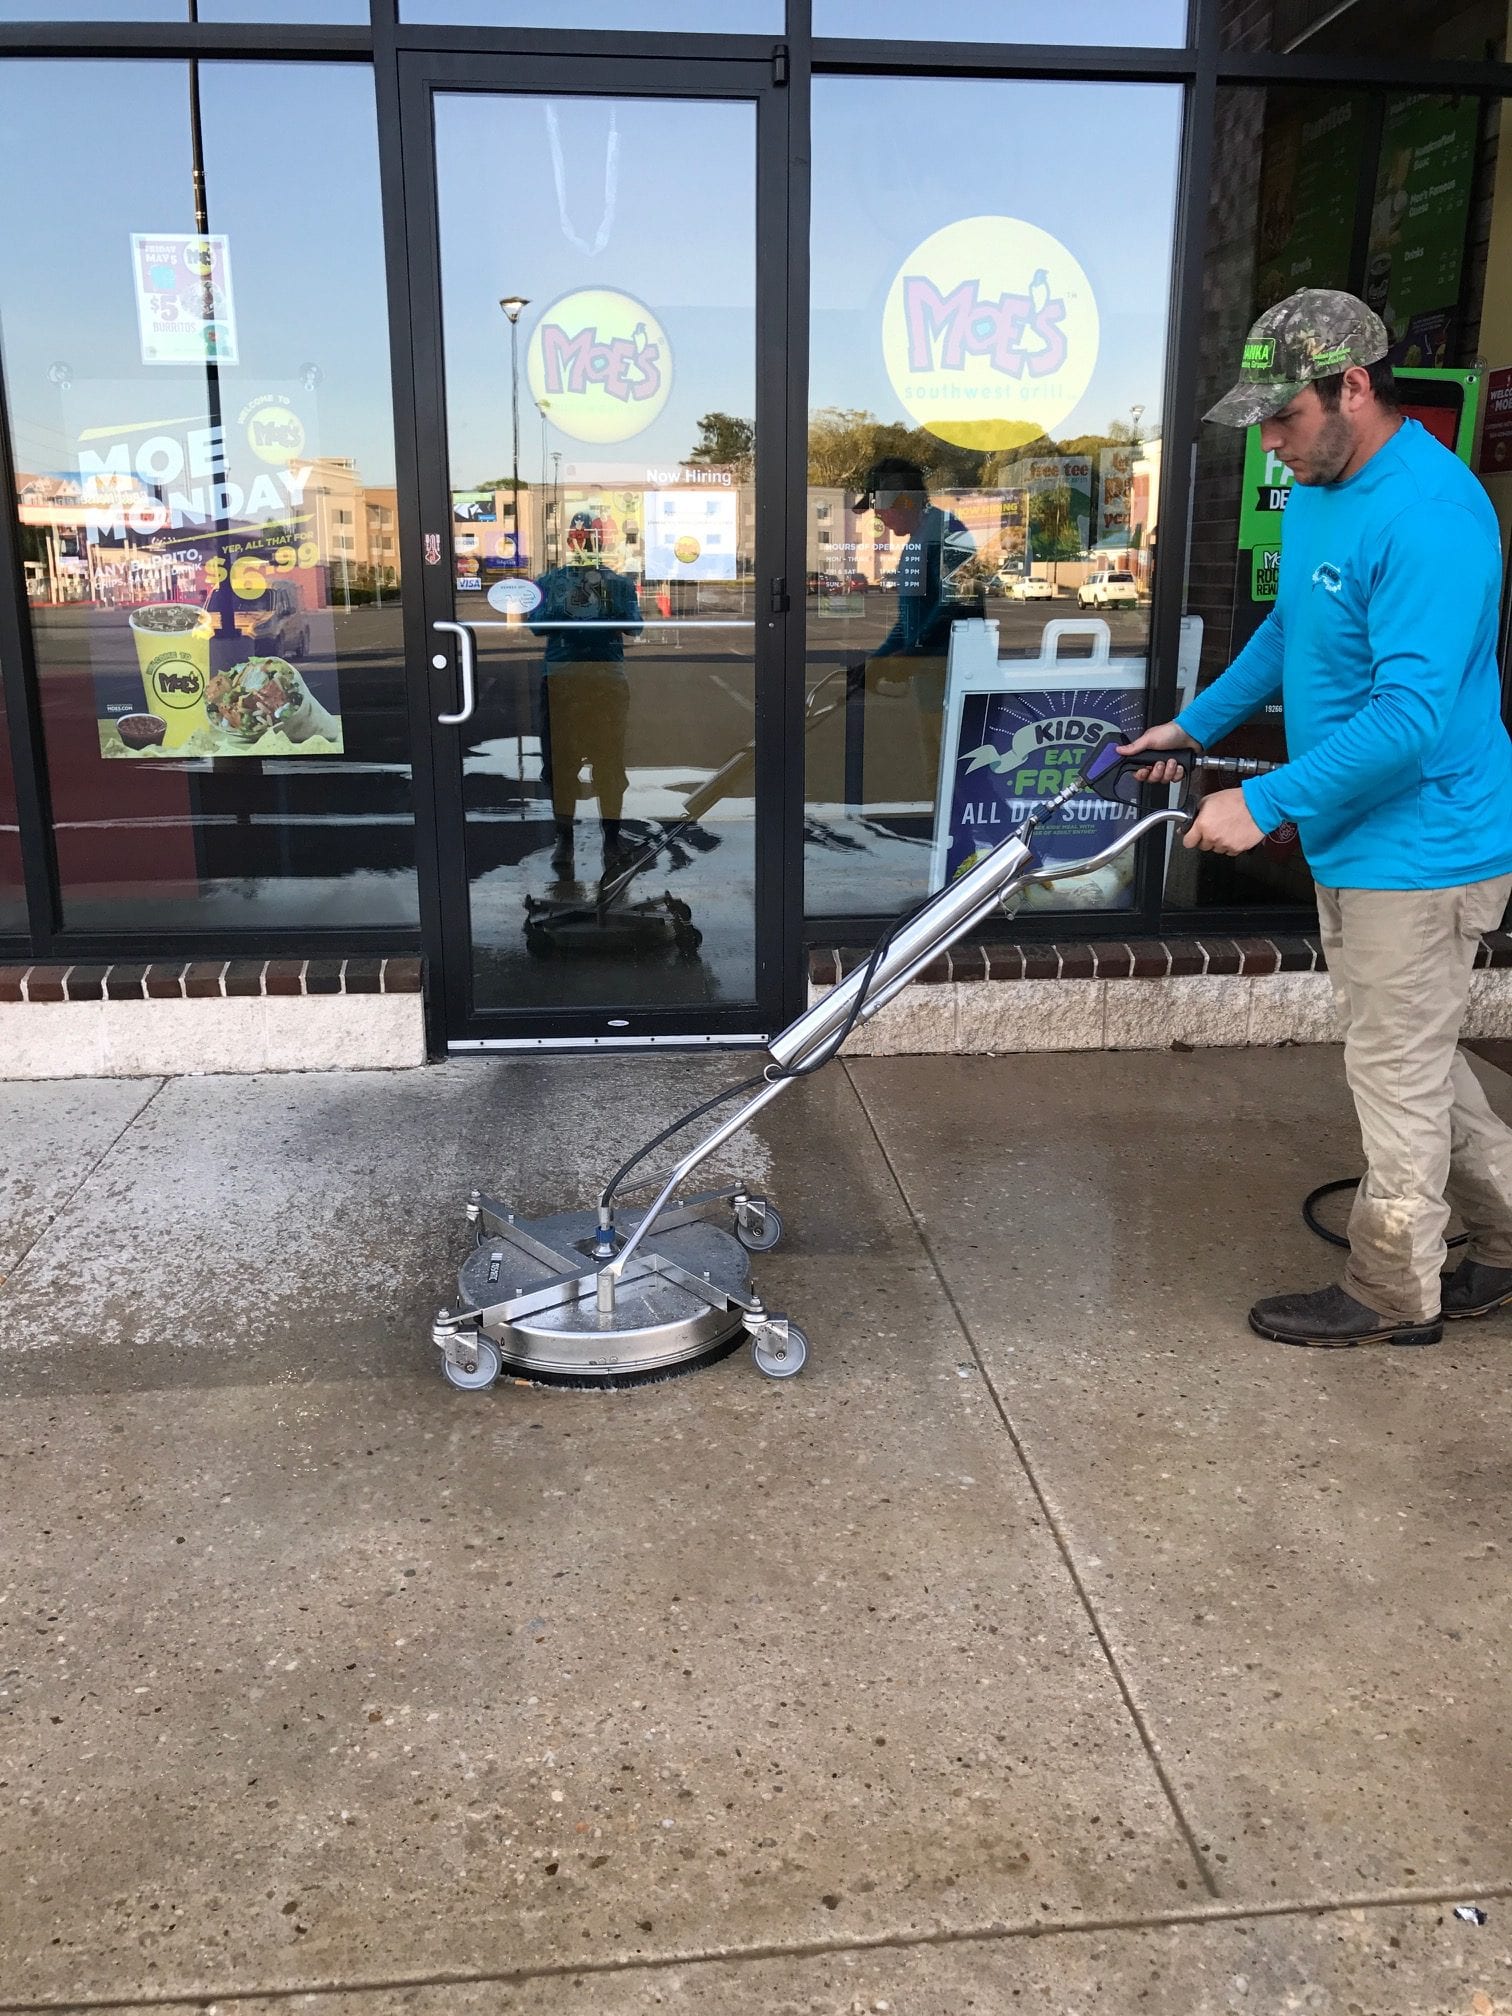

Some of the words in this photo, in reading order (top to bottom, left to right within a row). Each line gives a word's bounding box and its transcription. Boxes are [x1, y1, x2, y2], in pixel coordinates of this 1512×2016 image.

[144, 245, 176, 253] FRIDAY
[145, 254, 169, 263] MAY
[153, 322, 196, 333] BURRITOS
[904, 383, 1011, 400] southwest
[1020, 383, 1063, 402] grill
[236, 394, 274, 425] WELCOME
[278, 395, 291, 405] TO
[78, 425, 228, 496] MOE
[1030, 461, 1059, 477] free
[1064, 462, 1089, 477] tee
[646, 469, 680, 483] Now
[685, 469, 732, 486] Hiring
[86, 466, 314, 544] MONDAY
[245, 540, 265, 551] ALL
[266, 535, 292, 546] THAT
[294, 531, 314, 542] FOR
[825, 543, 856, 551] HOURS
[873, 543, 921, 551] OPERATION
[95, 561, 127, 578] ANY
[460, 580, 480, 588] VISA
[1034, 719, 1104, 745] KIDS
[1045, 749, 1087, 766] EAT
[1015, 768, 1095, 796] FRE
[961, 802, 1001, 825] ALL
[1062, 798, 1138, 822] SUNDA
